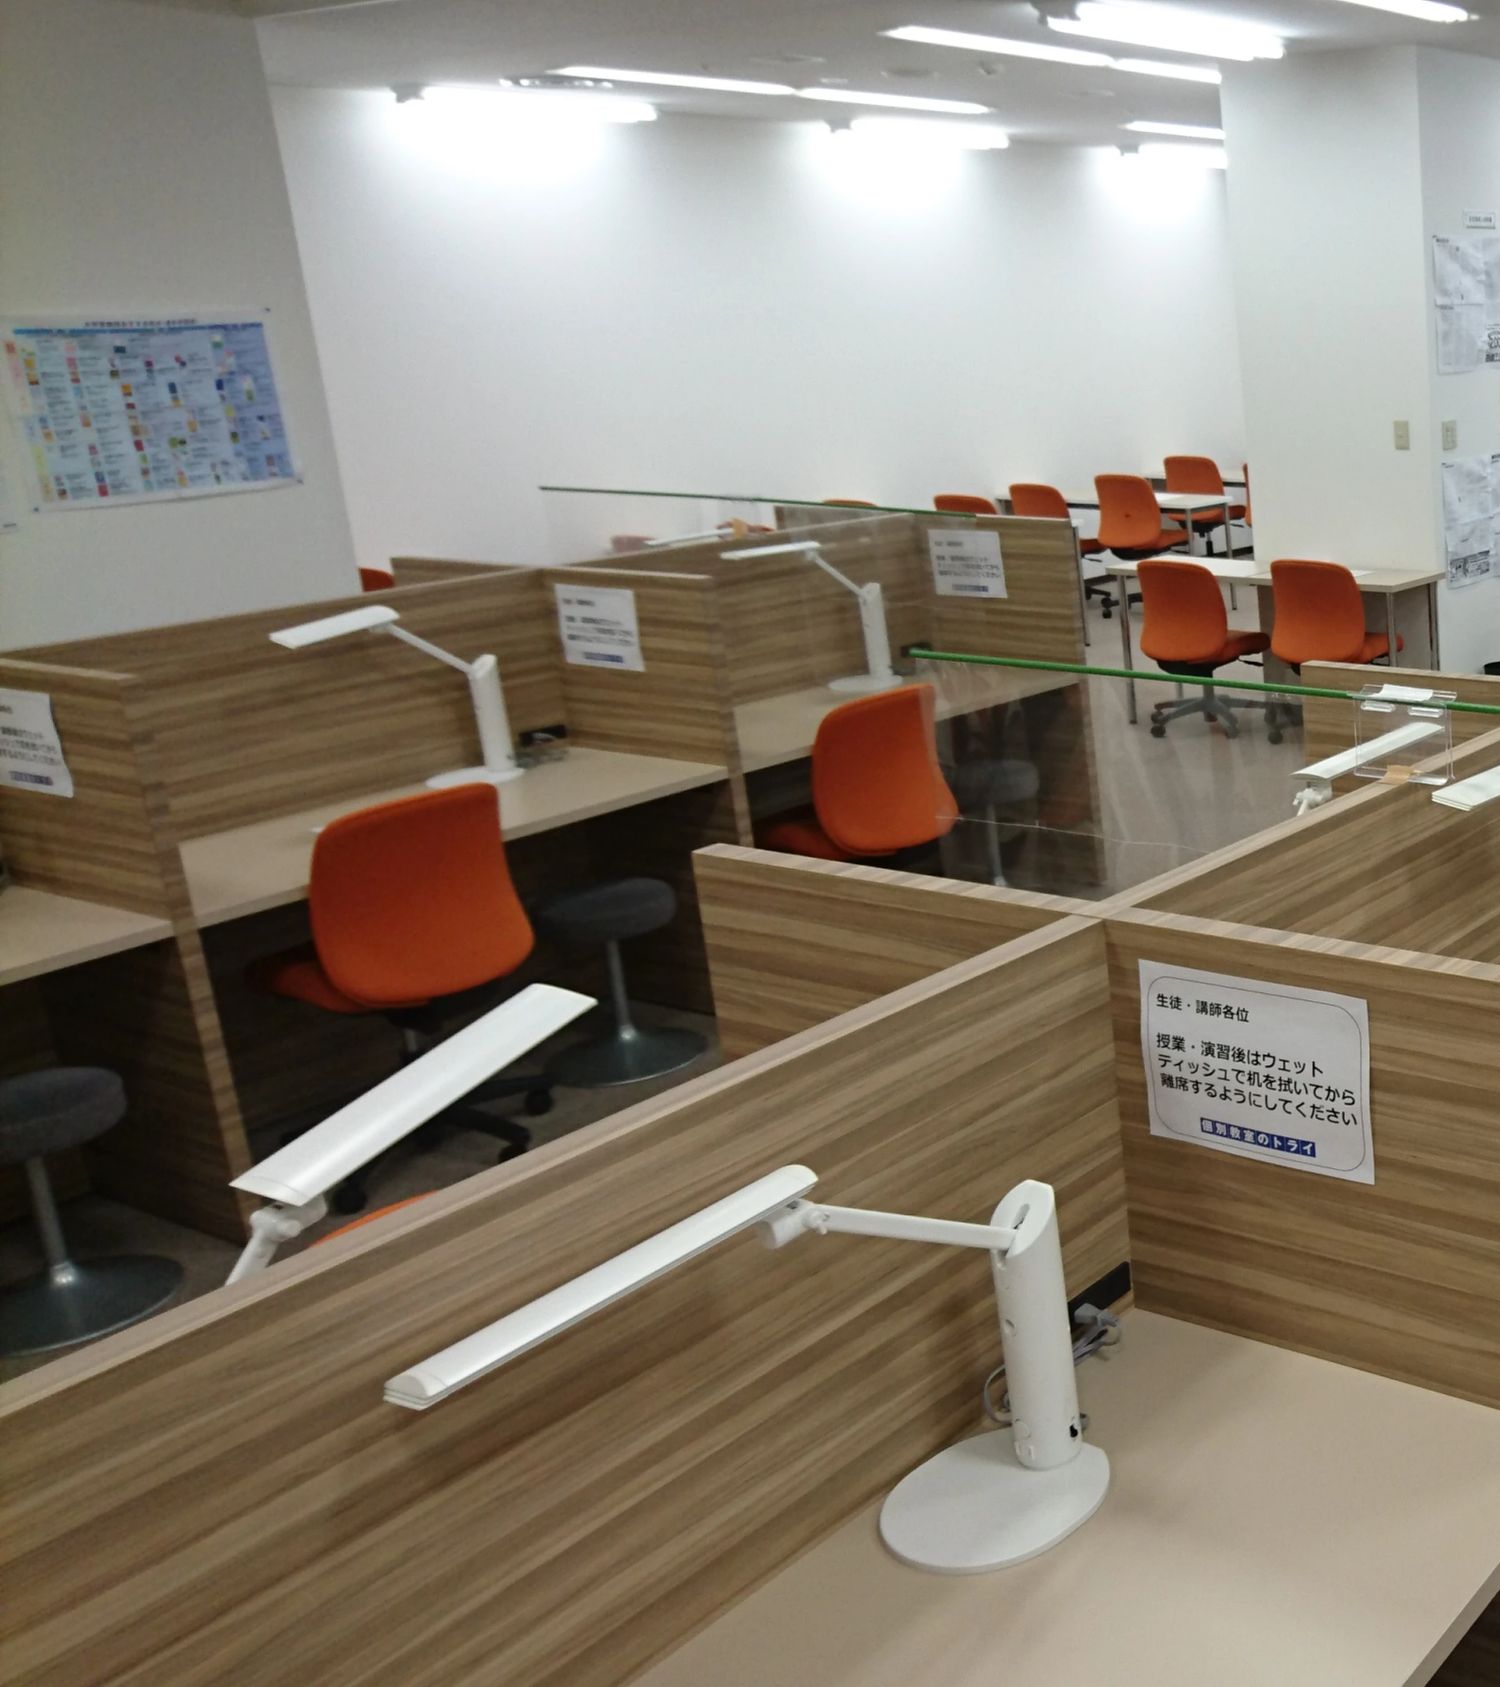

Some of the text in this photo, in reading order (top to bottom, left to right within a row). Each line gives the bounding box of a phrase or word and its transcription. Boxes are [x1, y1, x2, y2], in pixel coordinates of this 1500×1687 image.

[1156, 993, 1249, 1023] 生徒・講師各位
[1156, 1032, 1323, 1078] 授業・演習後はウェット
[1157, 1054, 1356, 1106] ティッシュで机を拭いてから
[1161, 1073, 1358, 1126] 離席するようにしてください
[1201, 1118, 1316, 1157] 個別教室のトライ
